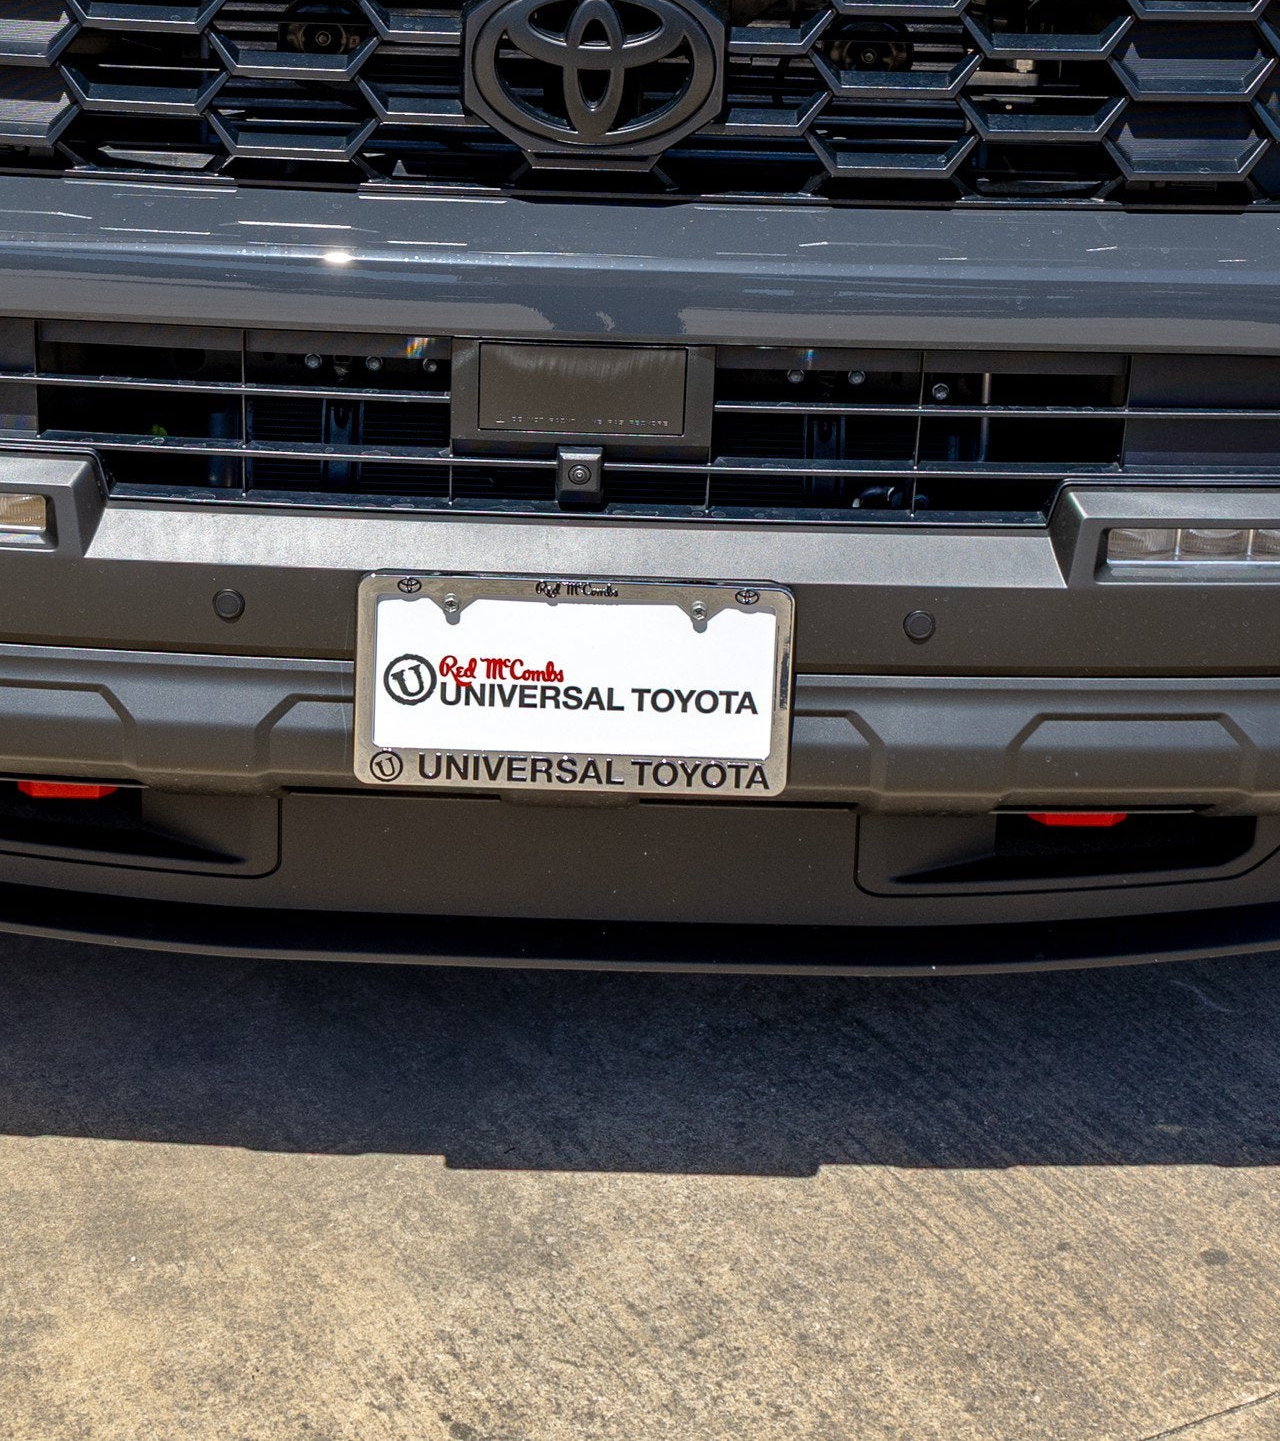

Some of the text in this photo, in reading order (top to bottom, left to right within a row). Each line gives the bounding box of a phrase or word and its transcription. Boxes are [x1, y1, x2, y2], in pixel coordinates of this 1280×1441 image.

[535, 580, 619, 598] Red McCombs
[439, 655, 564, 687] Red McCombs
[440, 683, 759, 715] UNIVERSAL TOYOTA
[418, 752, 770, 790] UNIVERSAL TOYOTA
